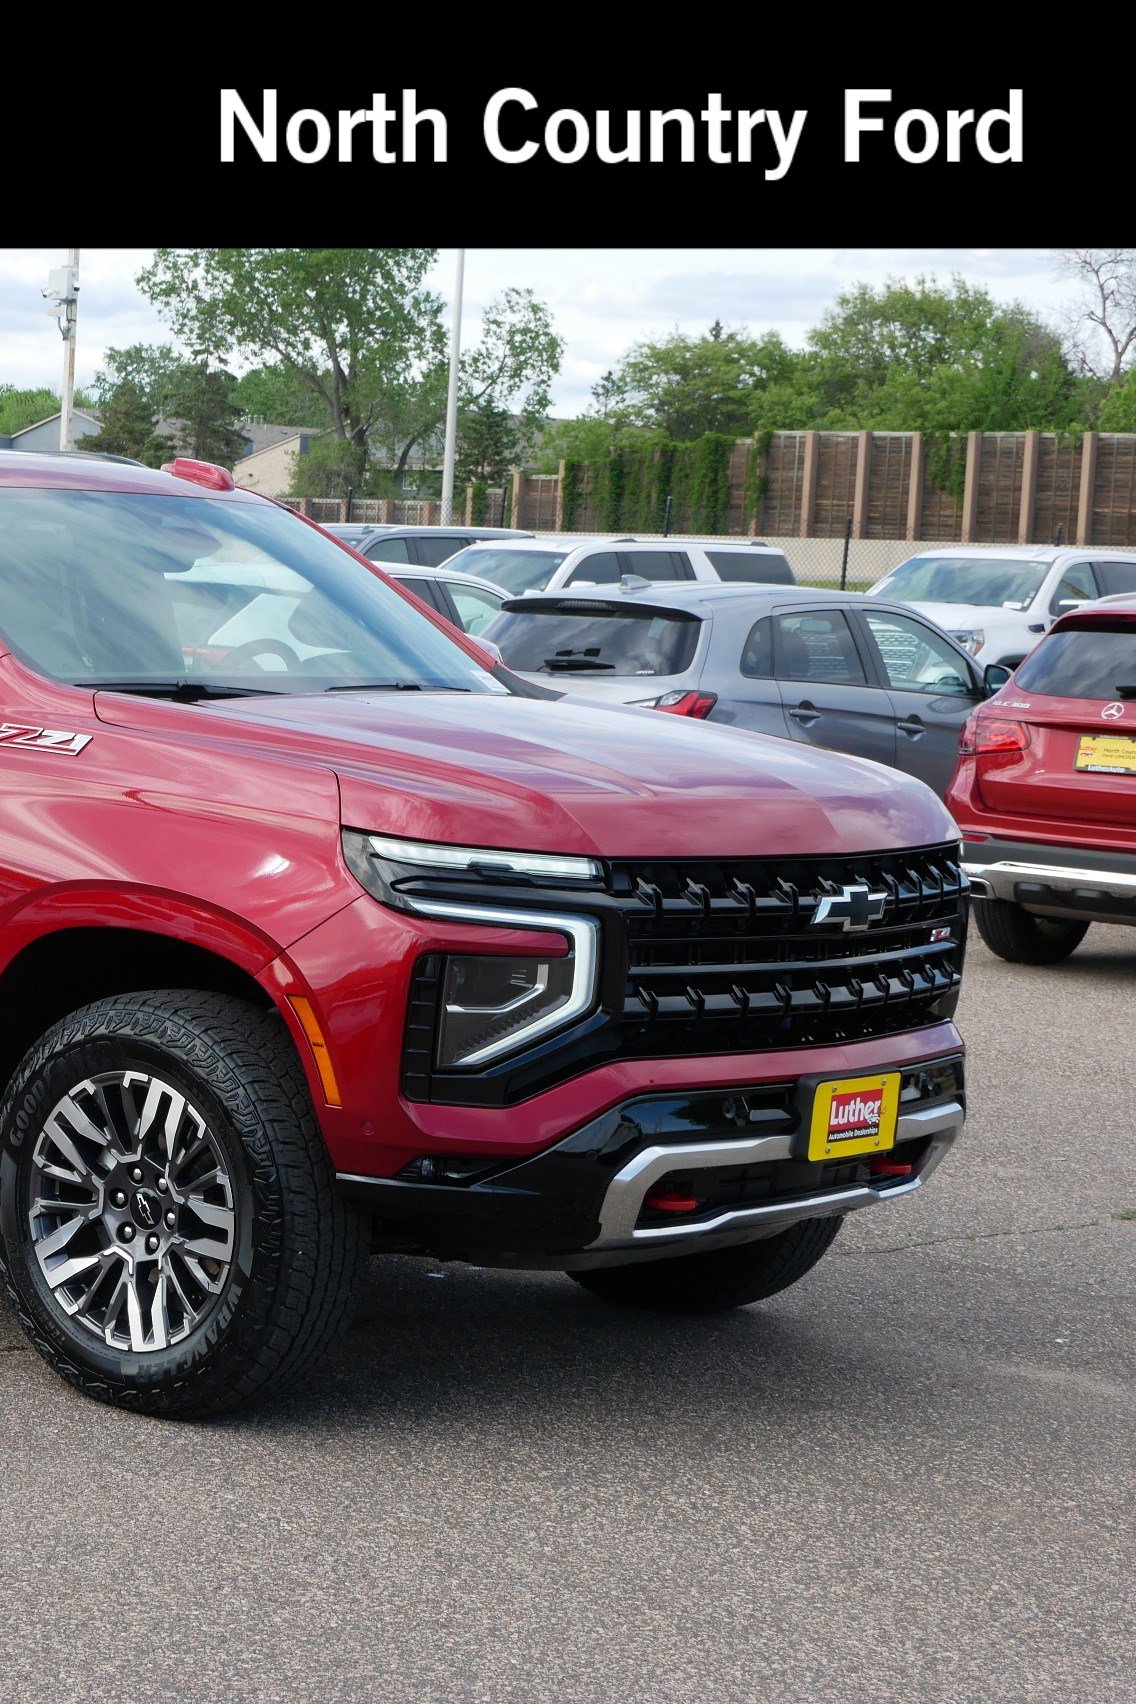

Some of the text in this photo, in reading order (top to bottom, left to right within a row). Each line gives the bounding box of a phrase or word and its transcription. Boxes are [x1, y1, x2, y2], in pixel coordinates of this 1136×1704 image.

[830, 1097, 882, 1126] Luther
[828, 1127, 879, 1141] Automobile Dealerships
